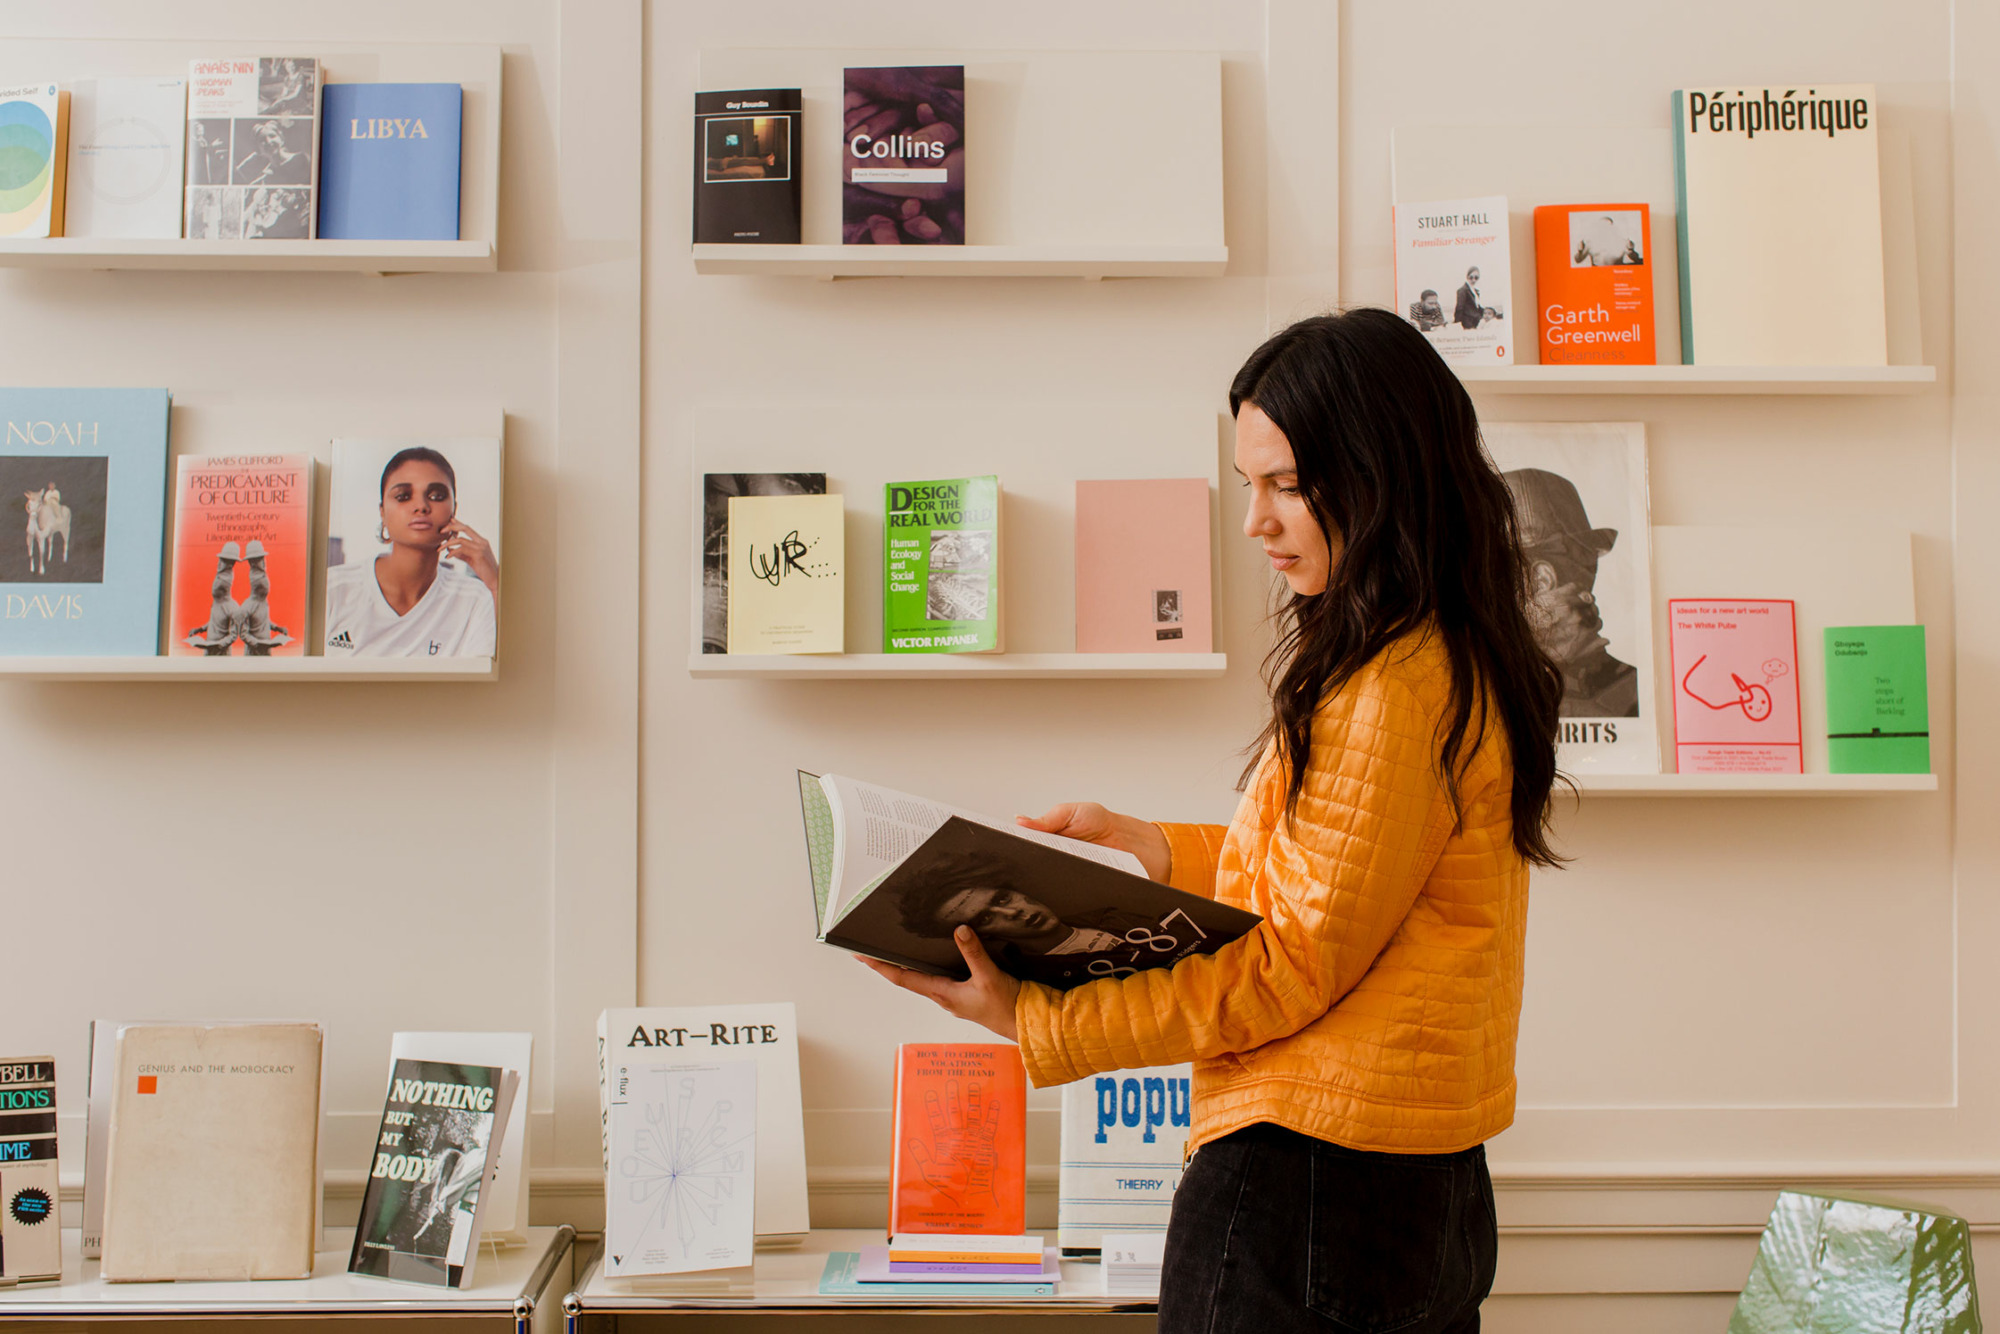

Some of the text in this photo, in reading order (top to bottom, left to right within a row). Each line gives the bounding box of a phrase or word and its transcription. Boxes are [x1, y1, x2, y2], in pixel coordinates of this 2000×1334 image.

[233, 61, 254, 74] NIN
[22, 87, 38, 96] Self
[1690, 89, 1868, 139] Périphérique
[350, 118, 429, 139] LIBYA
[851, 133, 945, 159] Collins
[1418, 213, 1489, 229] STUART HALL
[1412, 235, 1496, 248] Familiar Stranger
[1545, 302, 1609, 325] Garth
[1546, 323, 1640, 345] Greenwell
[1548, 347, 1626, 362] Cleanness
[7, 420, 99, 446] NOAH
[207, 455, 284, 466] JAMES CLIFFORD
[190, 473, 298, 489] PREDICAMENT
[198, 489, 290, 505] OF CULTURE
[891, 485, 959, 511] DESIGN
[913, 500, 961, 511] FOR THE
[890, 508, 992, 527] REAL WORLD
[264, 533, 277, 541] Art
[890, 539, 919, 548] Human
[890, 549, 922, 560] Ecology
[890, 560, 905, 570] and
[890, 571, 914, 581] Social
[890, 583, 920, 593] Change
[5, 593, 83, 620] DAVIS
[328, 640, 354, 650] adidas
[892, 633, 979, 649] VICTOR PAPANEK
[1896, 697, 1904, 705] of
[916, 1051, 938, 1059] HOW
[958, 1051, 993, 1060] CHOOSE
[138, 1064, 295, 1074] GENIUS AND THE MOBOCRACY
[930, 1060, 982, 1068] VOCATIONS
[0, 1064, 46, 1084] BELL
[916, 1068, 995, 1078] FROM THE HAND
[389, 1078, 494, 1112] NOTHING
[384, 1110, 414, 1126] BUT
[379, 1131, 404, 1147] MY
[371, 1152, 438, 1184] BODY
[1116, 1179, 1164, 1190] THIERRY
